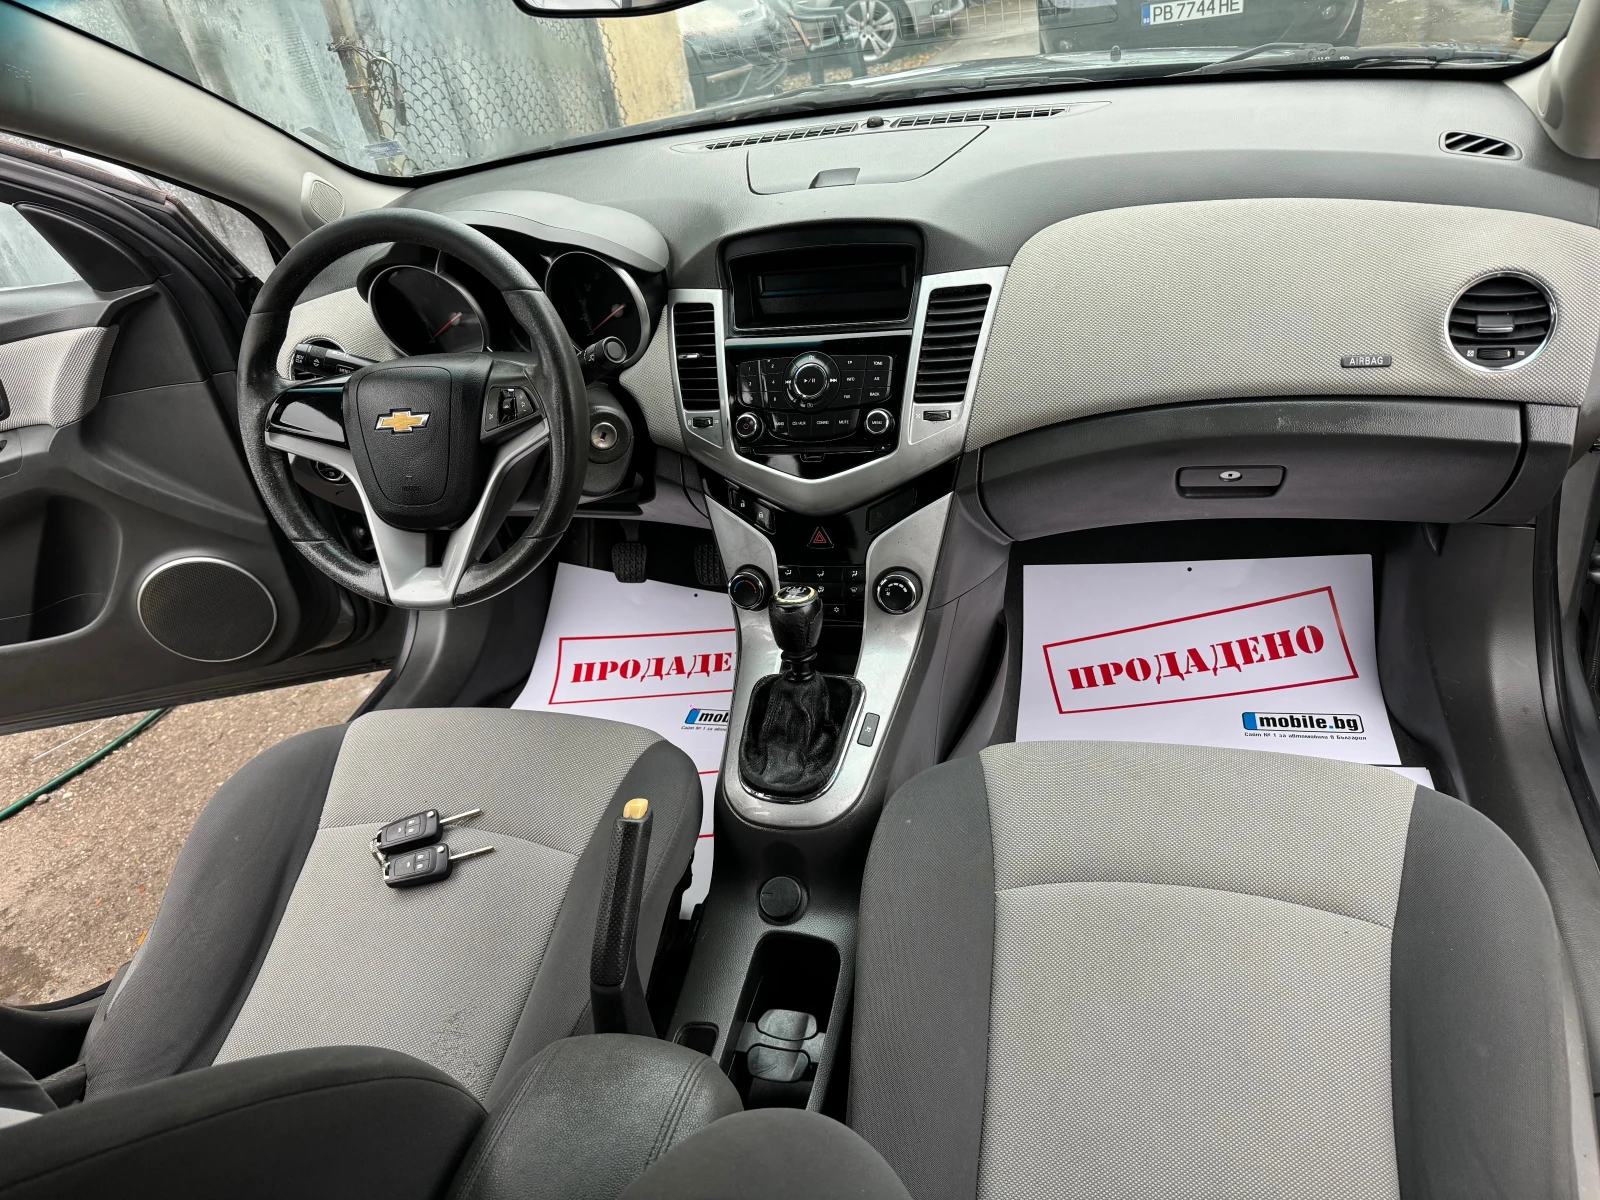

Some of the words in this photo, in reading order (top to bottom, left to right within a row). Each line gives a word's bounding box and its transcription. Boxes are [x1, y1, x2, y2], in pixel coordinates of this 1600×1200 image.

[1153, 5, 1173, 22] PB
[1176, 0, 1216, 19] 7744
[1219, 0, 1240, 14] HE
[1349, 356, 1384, 366] AIRBAG
[1067, 624, 1325, 684] ПРОДАДЕНО
[571, 652, 735, 683] ПРОДАДЕ
[1259, 715, 1359, 731] mobile.bg
